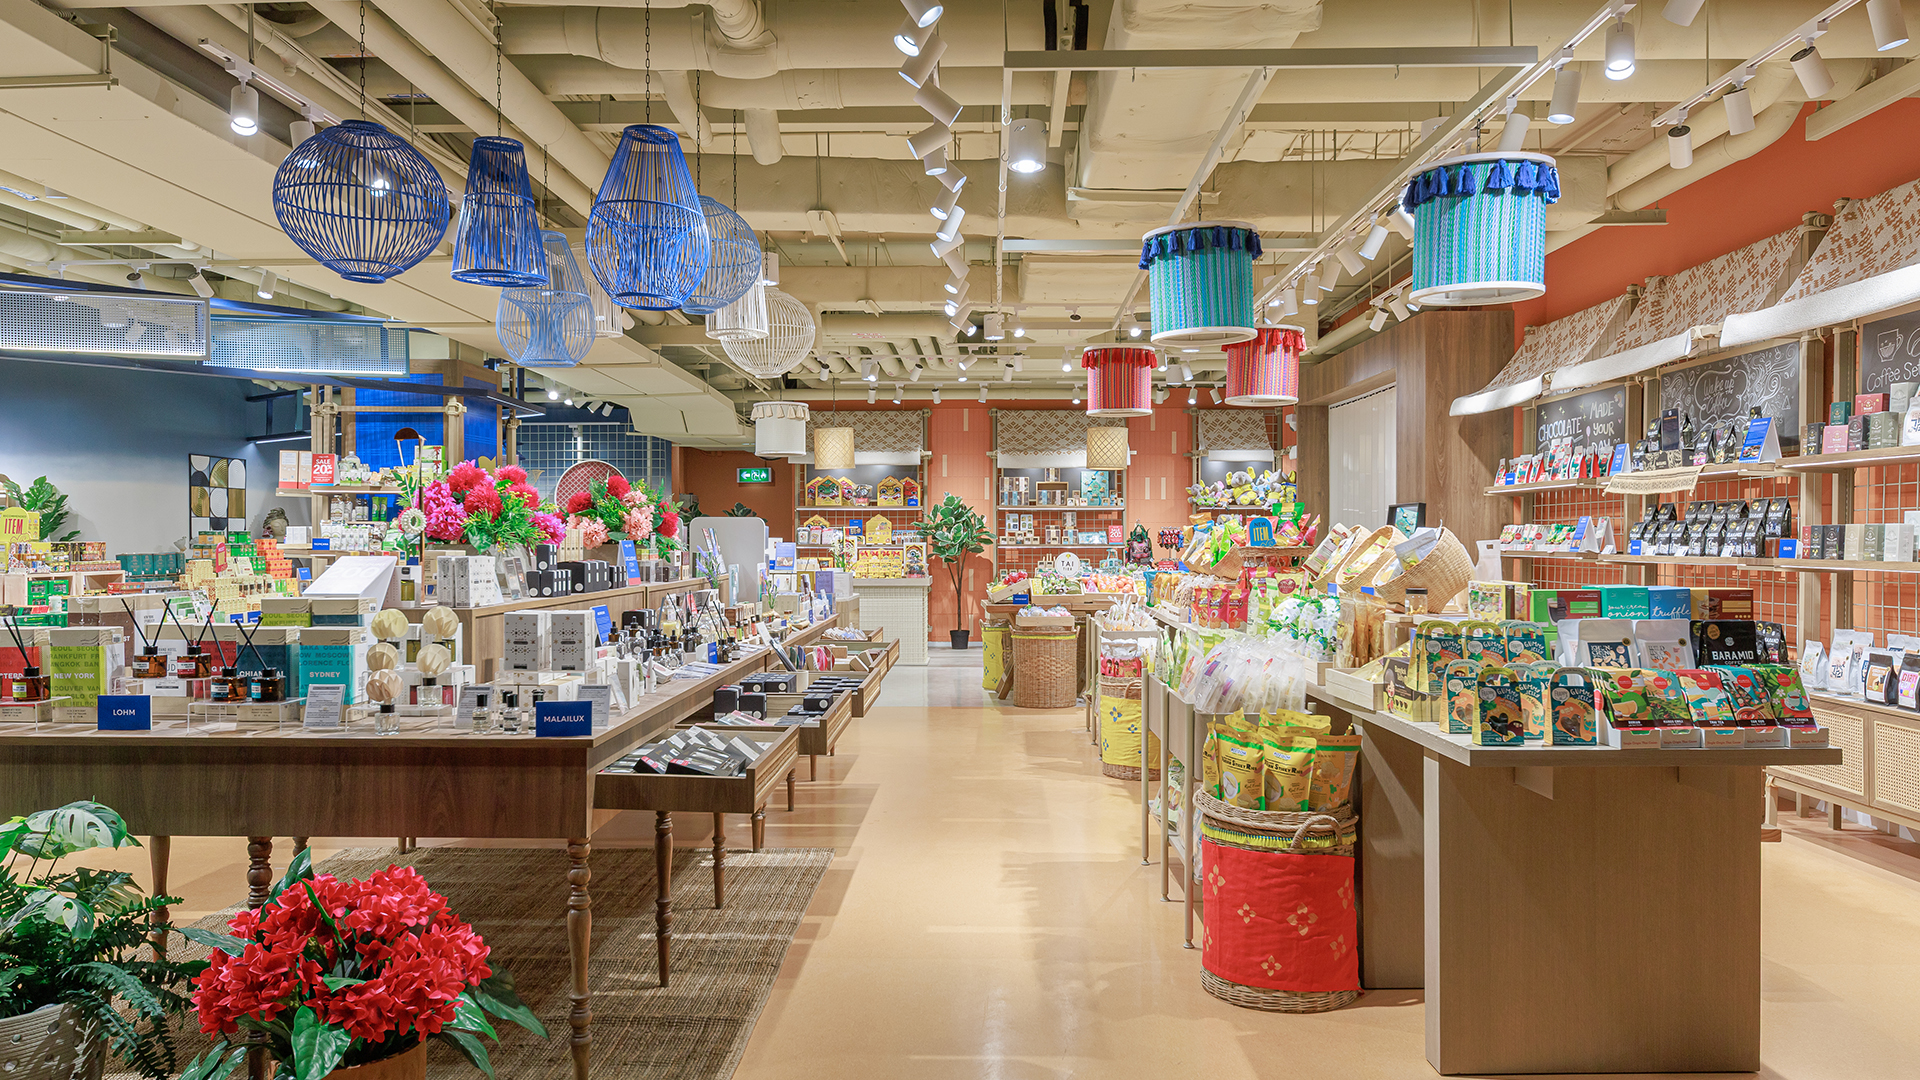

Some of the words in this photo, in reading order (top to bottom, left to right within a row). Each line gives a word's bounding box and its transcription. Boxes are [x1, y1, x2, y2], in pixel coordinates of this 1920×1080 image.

[1866, 367, 1900, 392] Coffee
[1590, 400, 1615, 419] MADE
[1538, 416, 1582, 442] CHOCOLATE
[1593, 421, 1614, 436] YOUR
[4, 518, 23, 535] ITEM
[1253, 526, 1269, 541] ITEM
[1607, 609, 1649, 617] onion
[1651, 603, 1691, 617] truffle
[1711, 650, 1754, 660] BARAMIO
[1569, 688, 1593, 698] GUMMY
[543, 715, 585, 723] MALAILUX
